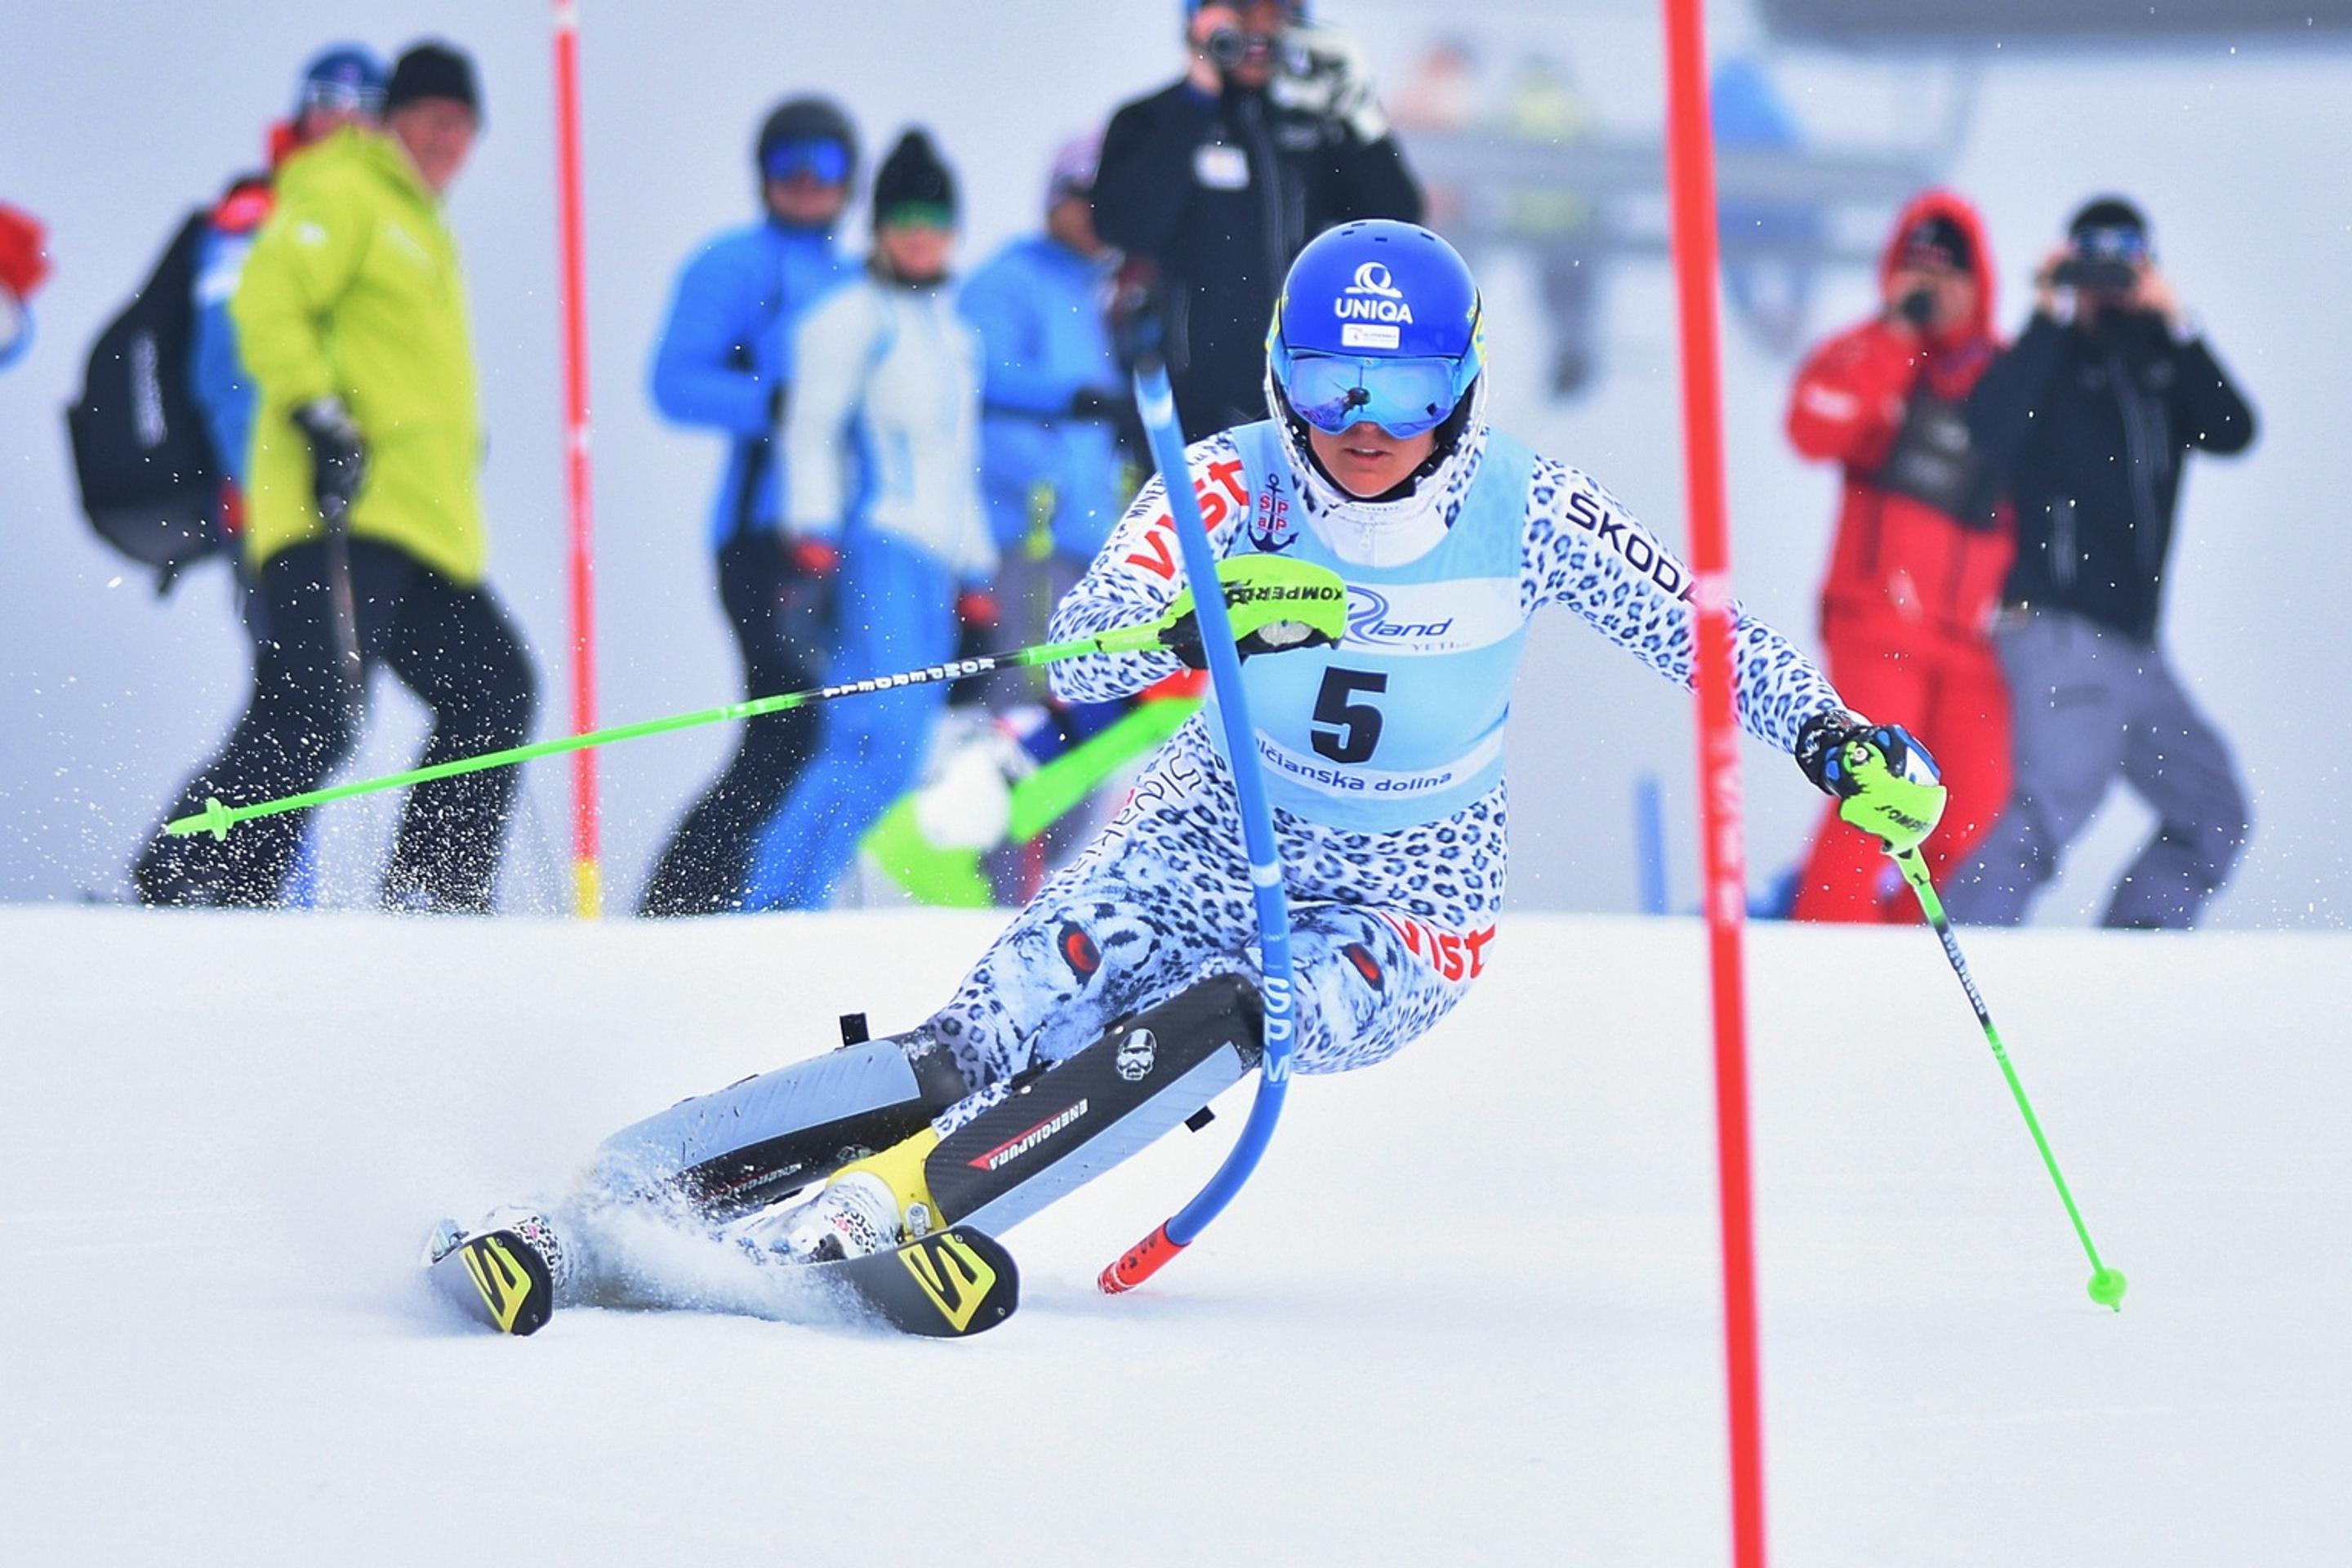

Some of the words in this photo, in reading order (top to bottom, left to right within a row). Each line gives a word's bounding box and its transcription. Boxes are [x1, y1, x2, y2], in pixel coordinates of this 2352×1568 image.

[1334, 297, 1414, 324] UNIQA
[1310, 666, 1388, 764] 5
[1374, 772, 1453, 792] dolina
[988, 1098, 1089, 1171] ENERGIAPURA
